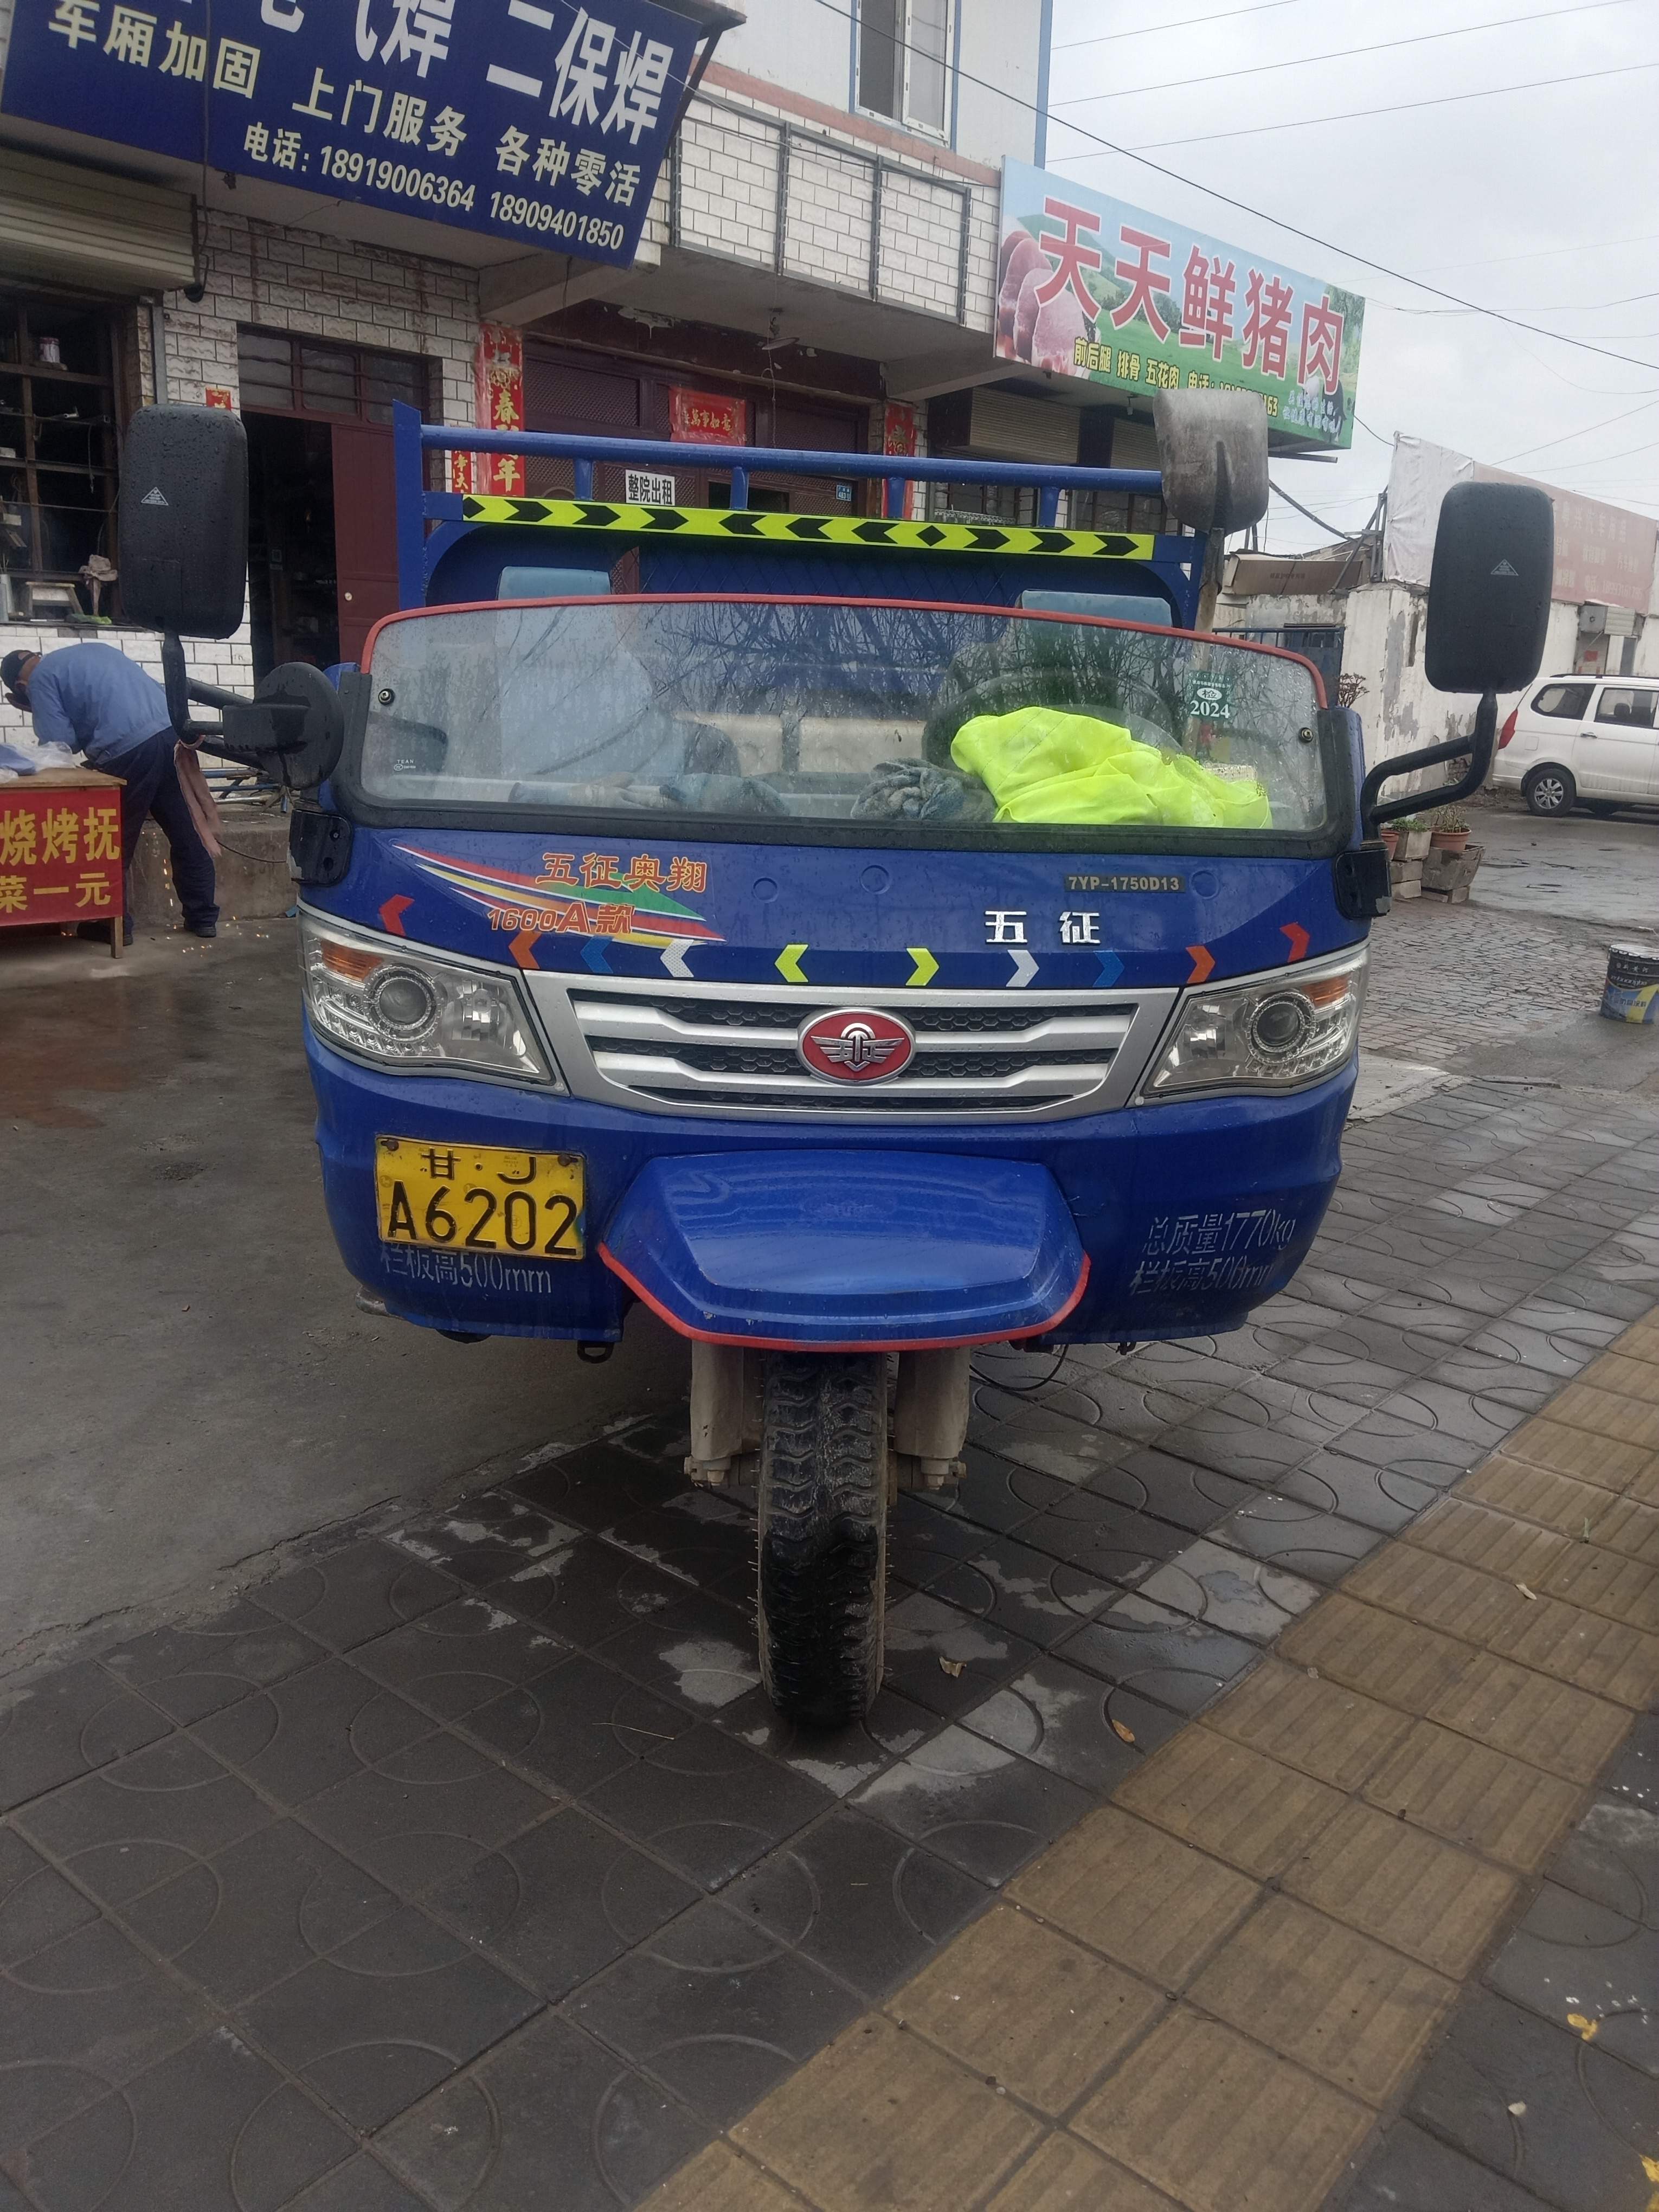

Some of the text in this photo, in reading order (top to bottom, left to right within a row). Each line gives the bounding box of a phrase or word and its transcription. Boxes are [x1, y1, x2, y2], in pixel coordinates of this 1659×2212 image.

[486, 0, 674, 145] 二保焊
[49, 0, 642, 207] 车厢加固 上门服务 各种零活
[490, 191, 624, 250] 18909401850
[1034, 195, 1345, 395] 天天鲜猪肉
[1074, 338, 1112, 373] 前后腿
[1116, 350, 1141, 381] 排骨
[1145, 358, 1180, 390] 五花肉
[628, 474, 673, 505] 整院出租
[1189, 700, 1230, 719] 2024
[535, 852, 707, 893] 五征奥翔
[1068, 876, 1180, 891] 7YP-1750D13
[387, 1180, 578, 1257] A6202
[1141, 1208, 1296, 1256] 总质量1770kg
